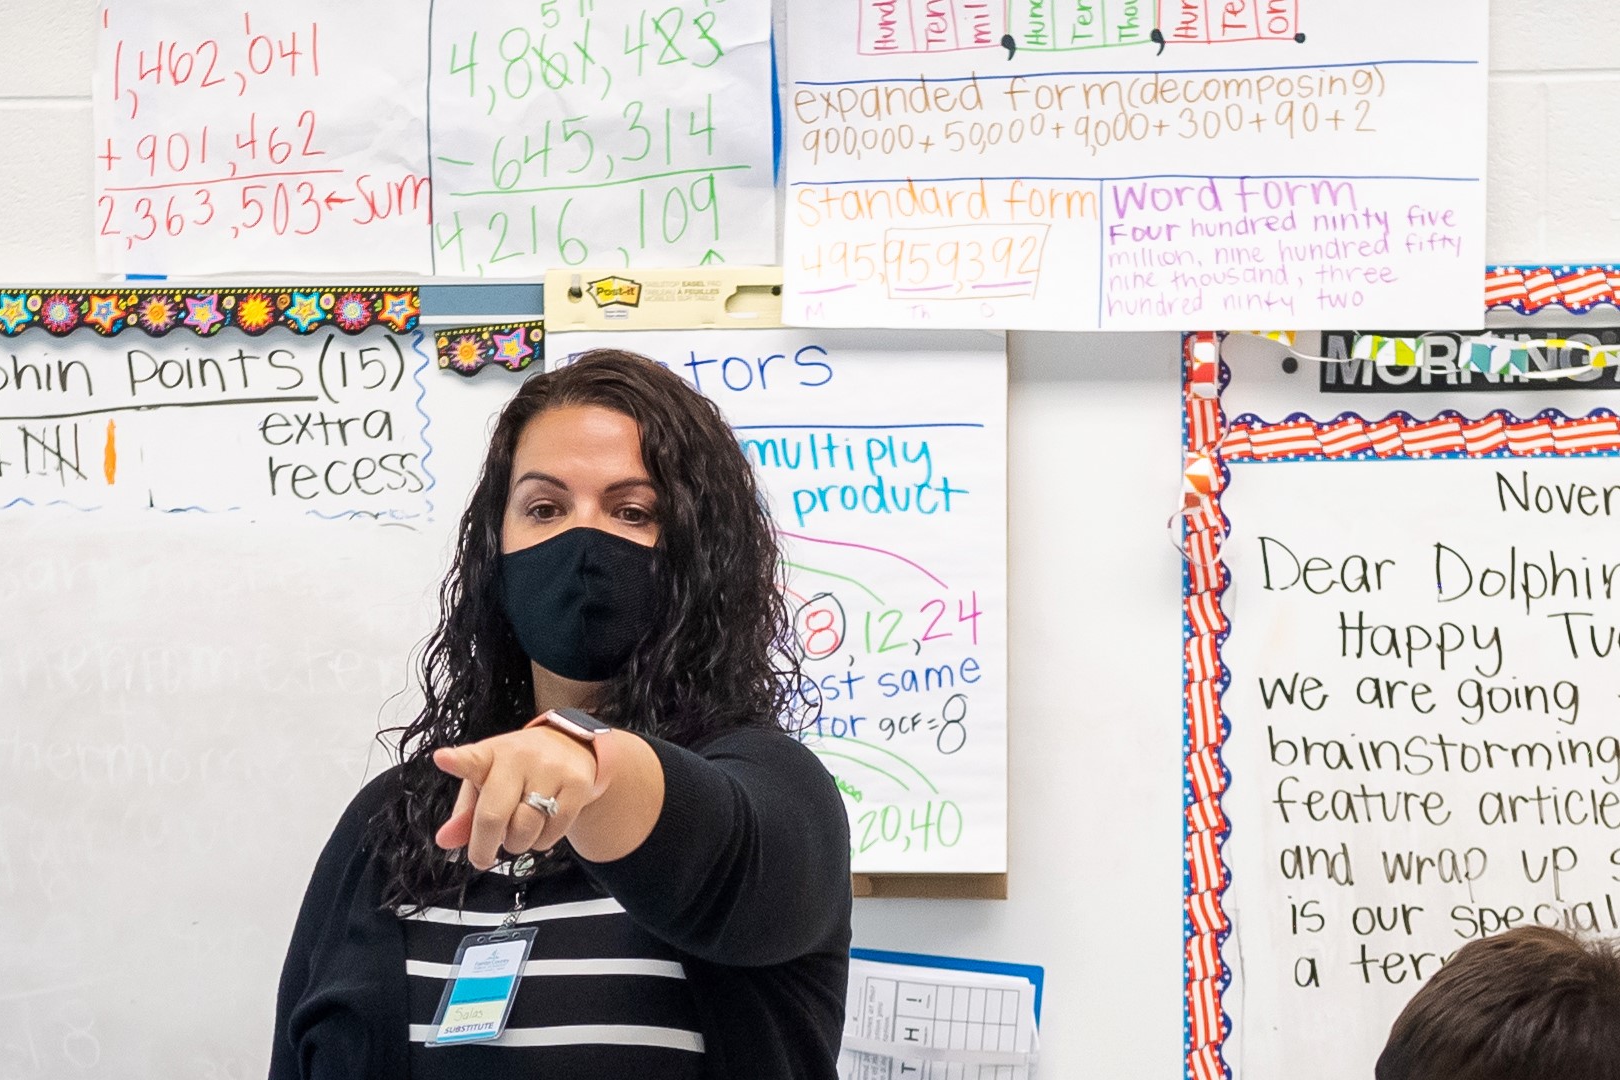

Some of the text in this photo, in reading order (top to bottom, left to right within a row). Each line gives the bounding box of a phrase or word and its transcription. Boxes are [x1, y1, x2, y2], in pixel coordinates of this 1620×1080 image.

[794, 70, 984, 124] expanded
[1003, 179, 1097, 220] form
[1234, 176, 1359, 213] form
[1108, 204, 1458, 246] Four hundred ninty five
[1214, 245, 1266, 266] nine
[1277, 234, 1389, 263] hundred
[1404, 232, 1463, 258] fifty
[596, 286, 637, 297] Post-it
[1108, 269, 1159, 292] nine
[1315, 264, 1399, 285] three
[1106, 287, 1365, 318] hundred ninty two
[317, 332, 407, 404] (15)
[259, 407, 394, 447] extra
[266, 452, 428, 500] recess
[741, 433, 932, 482] multiply
[792, 476, 970, 527] product
[1258, 536, 1396, 596] Dear
[1338, 611, 1503, 678] Happy
[877, 657, 982, 698] same
[1356, 676, 1437, 715] are
[1457, 675, 1581, 725] going
[1267, 725, 1620, 785] brainstorming
[1272, 776, 1452, 827] feature
[1280, 842, 1355, 886] and
[1382, 846, 1488, 904] wrap
[1521, 846, 1579, 902] up
[1286, 893, 1619, 939] is our special
[1294, 955, 1320, 988] a
[444, 1021, 495, 1034] SUBSTITUTE
